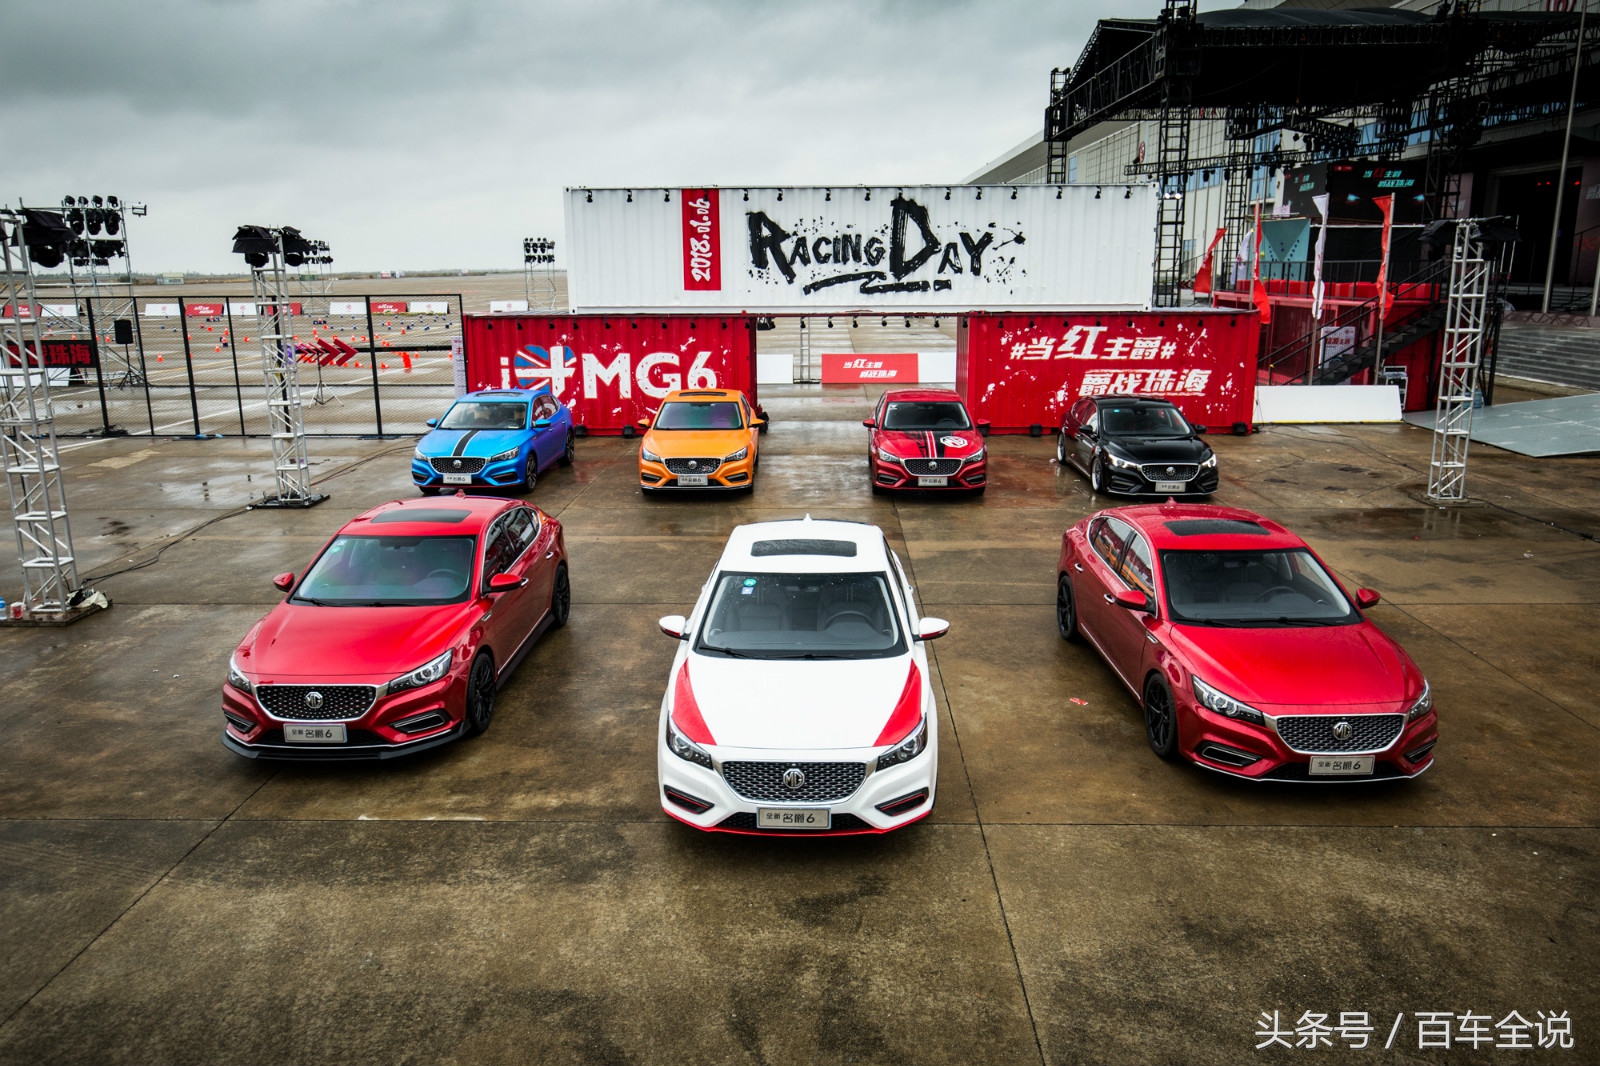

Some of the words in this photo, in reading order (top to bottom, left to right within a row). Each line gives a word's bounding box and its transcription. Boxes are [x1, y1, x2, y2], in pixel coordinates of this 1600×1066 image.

[688, 198, 712, 282] 2018.01.06
[582, 351, 718, 399] MG6
[1078, 369, 1212, 397] 爵战珠海
[784, 769, 804, 788] MG
